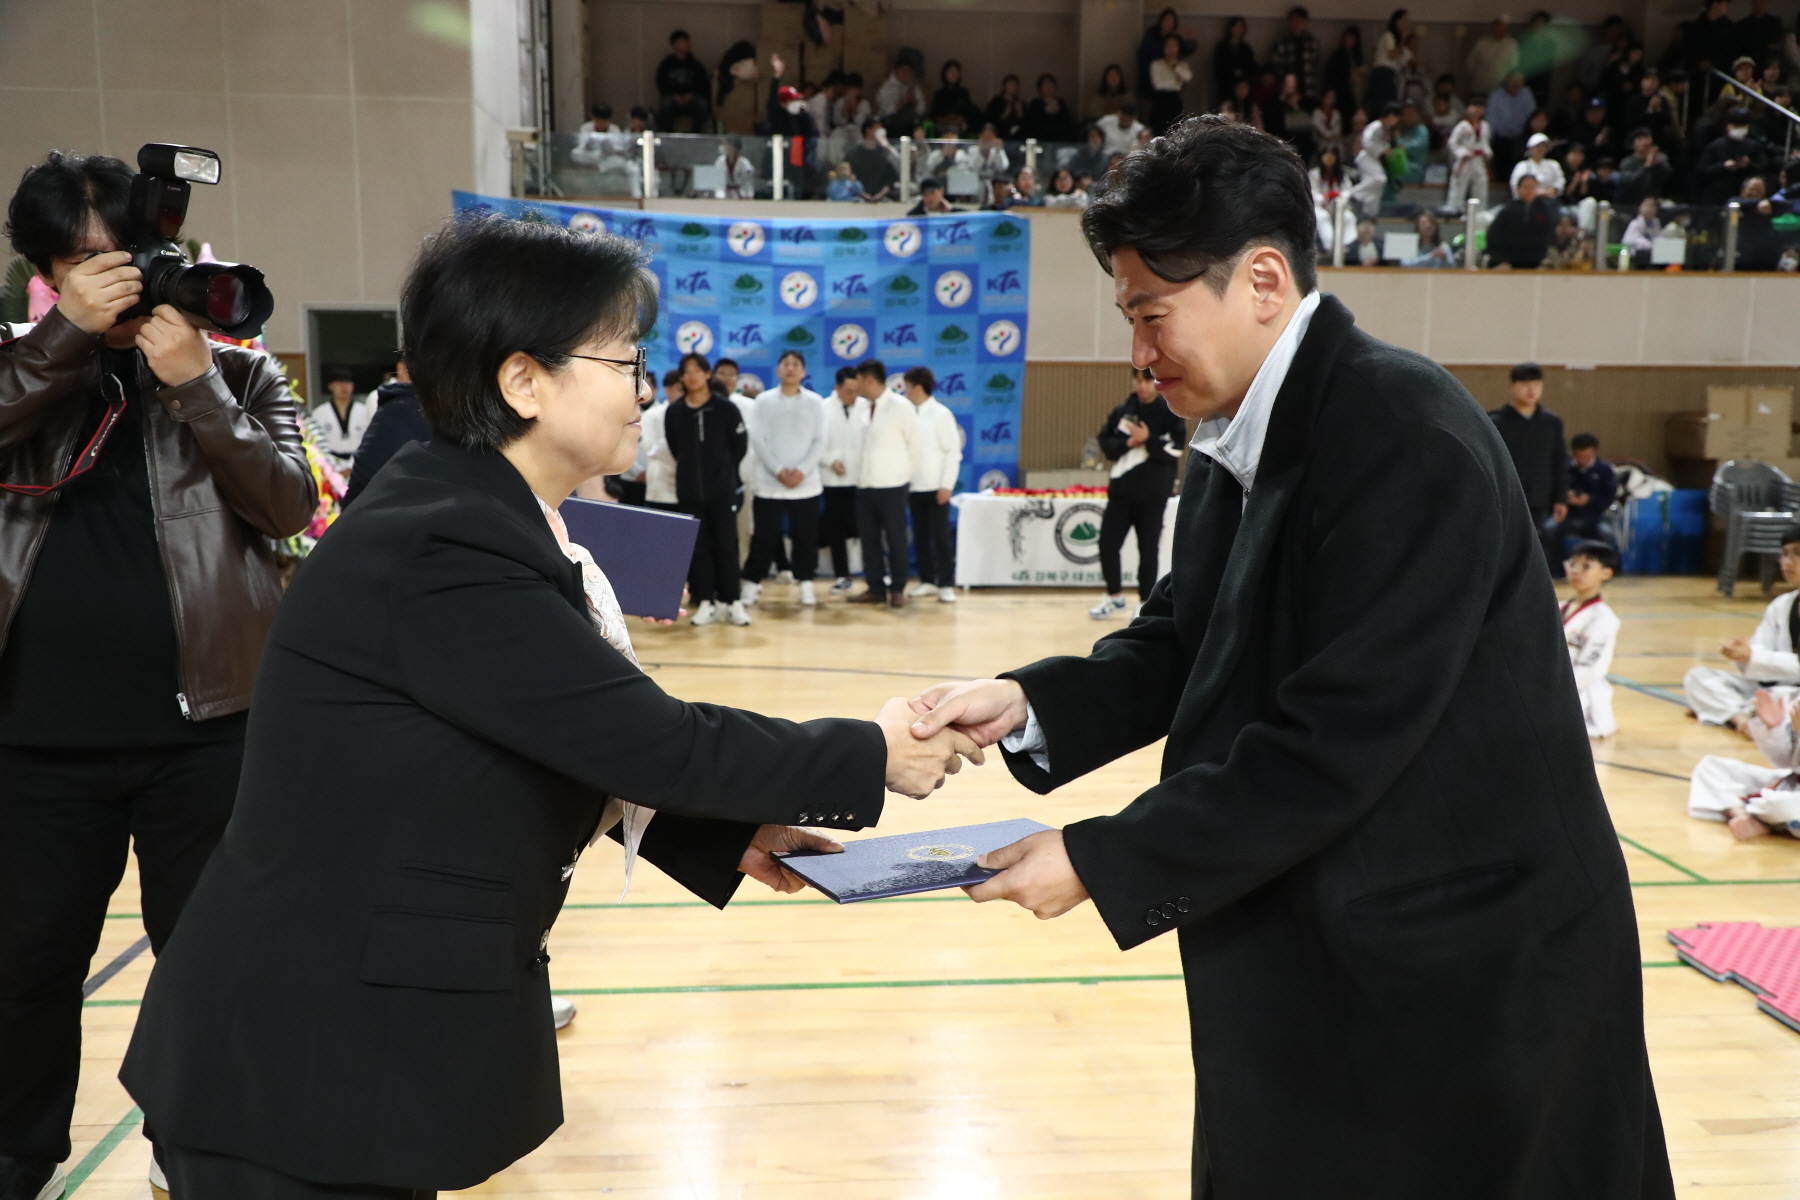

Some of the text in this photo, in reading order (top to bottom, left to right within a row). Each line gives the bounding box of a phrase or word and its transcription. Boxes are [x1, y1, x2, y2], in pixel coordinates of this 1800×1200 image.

[622, 218, 657, 239] KTA
[781, 226, 816, 244] KTA
[936, 221, 970, 244] KTA
[161, 249, 180, 257] Canon
[675, 271, 711, 294] KTA
[832, 274, 868, 298] KTA
[986, 270, 1021, 293] KTA
[728, 324, 763, 346] KTA
[883, 324, 918, 347] KTA
[933, 373, 966, 395] KTA
[981, 422, 1012, 443] KTA
